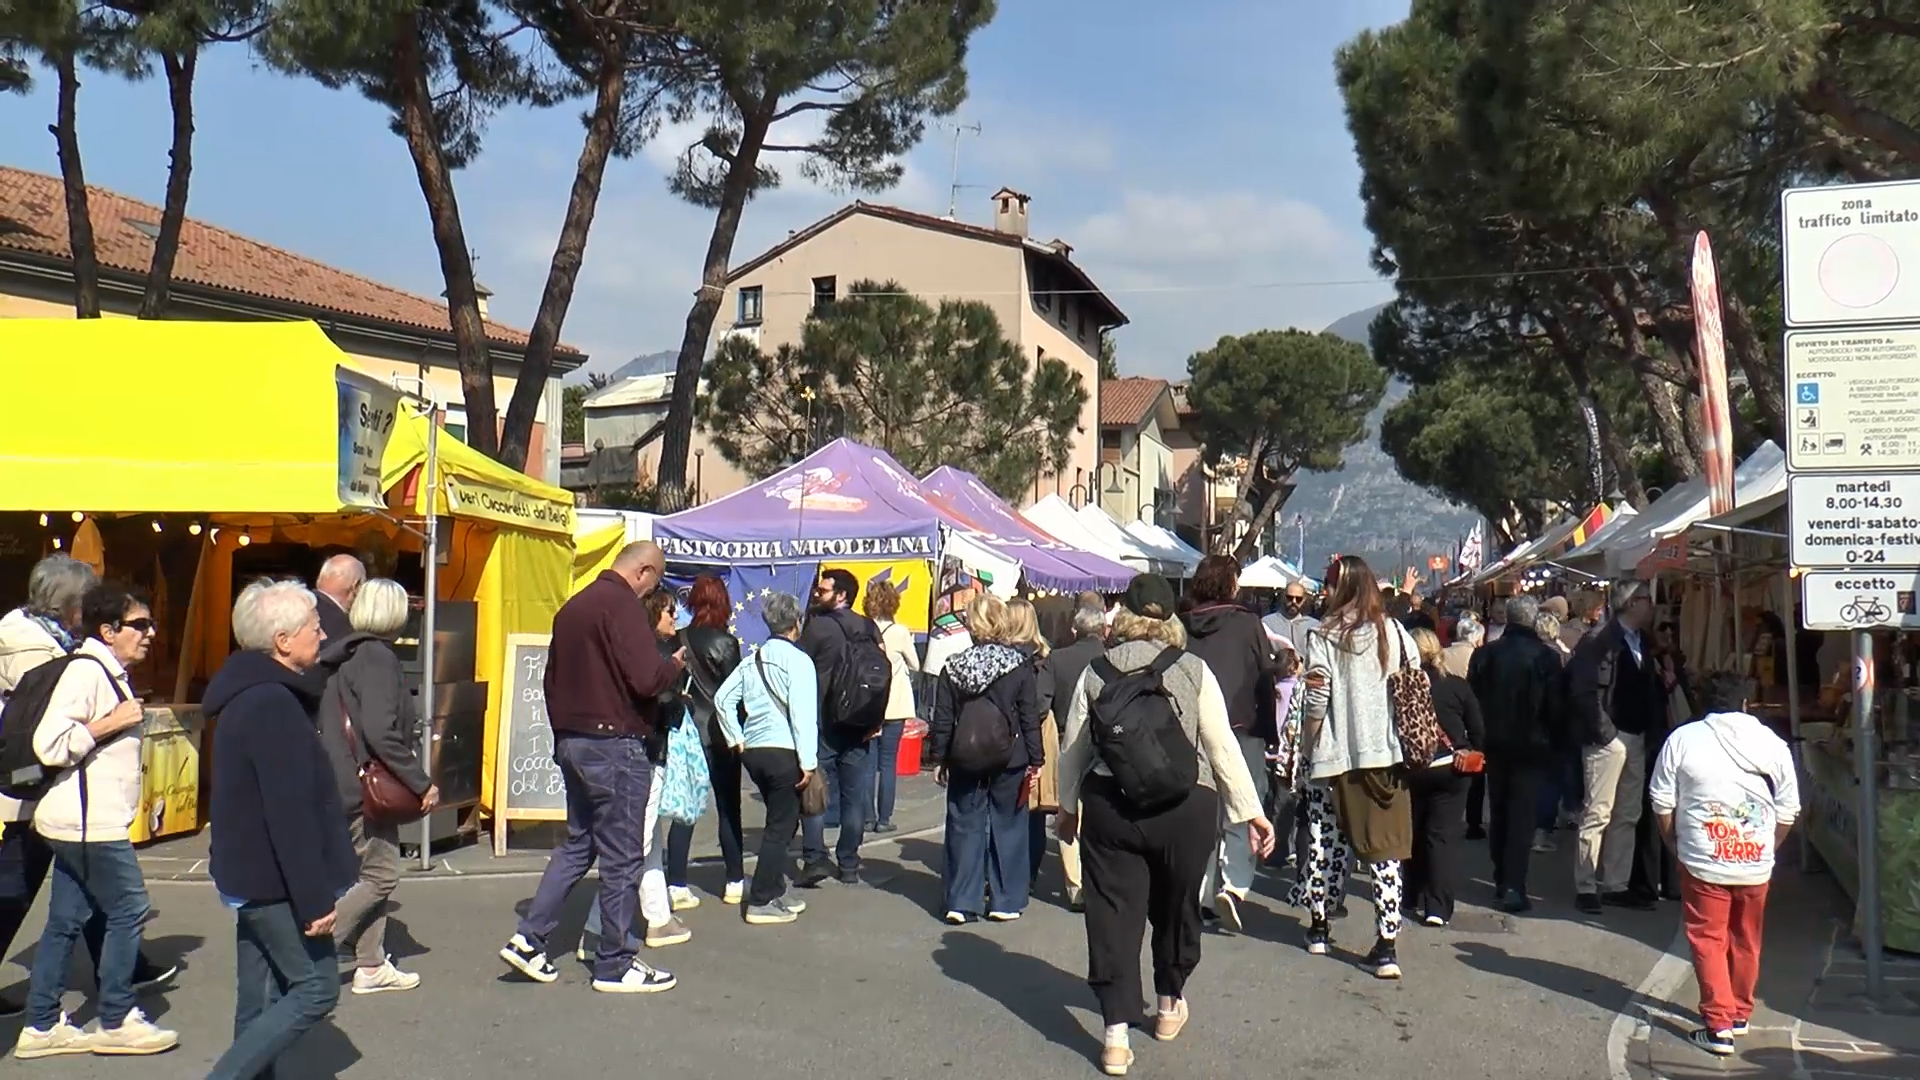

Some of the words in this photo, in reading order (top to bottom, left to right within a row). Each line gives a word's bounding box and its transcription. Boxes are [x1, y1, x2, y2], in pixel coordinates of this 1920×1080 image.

[1841, 199, 1872, 210] zona
[1799, 214, 1851, 228] traffico
[1860, 209, 1919, 224] limitato
[1841, 338, 1883, 346] TRANSITO
[788, 536, 932, 556] NAPOLETANA
[1846, 549, 1886, 563] 0-24
[1834, 577, 1896, 590] eccetto
[1703, 820, 1740, 840] TOM
[1709, 840, 1766, 863] JERRY
